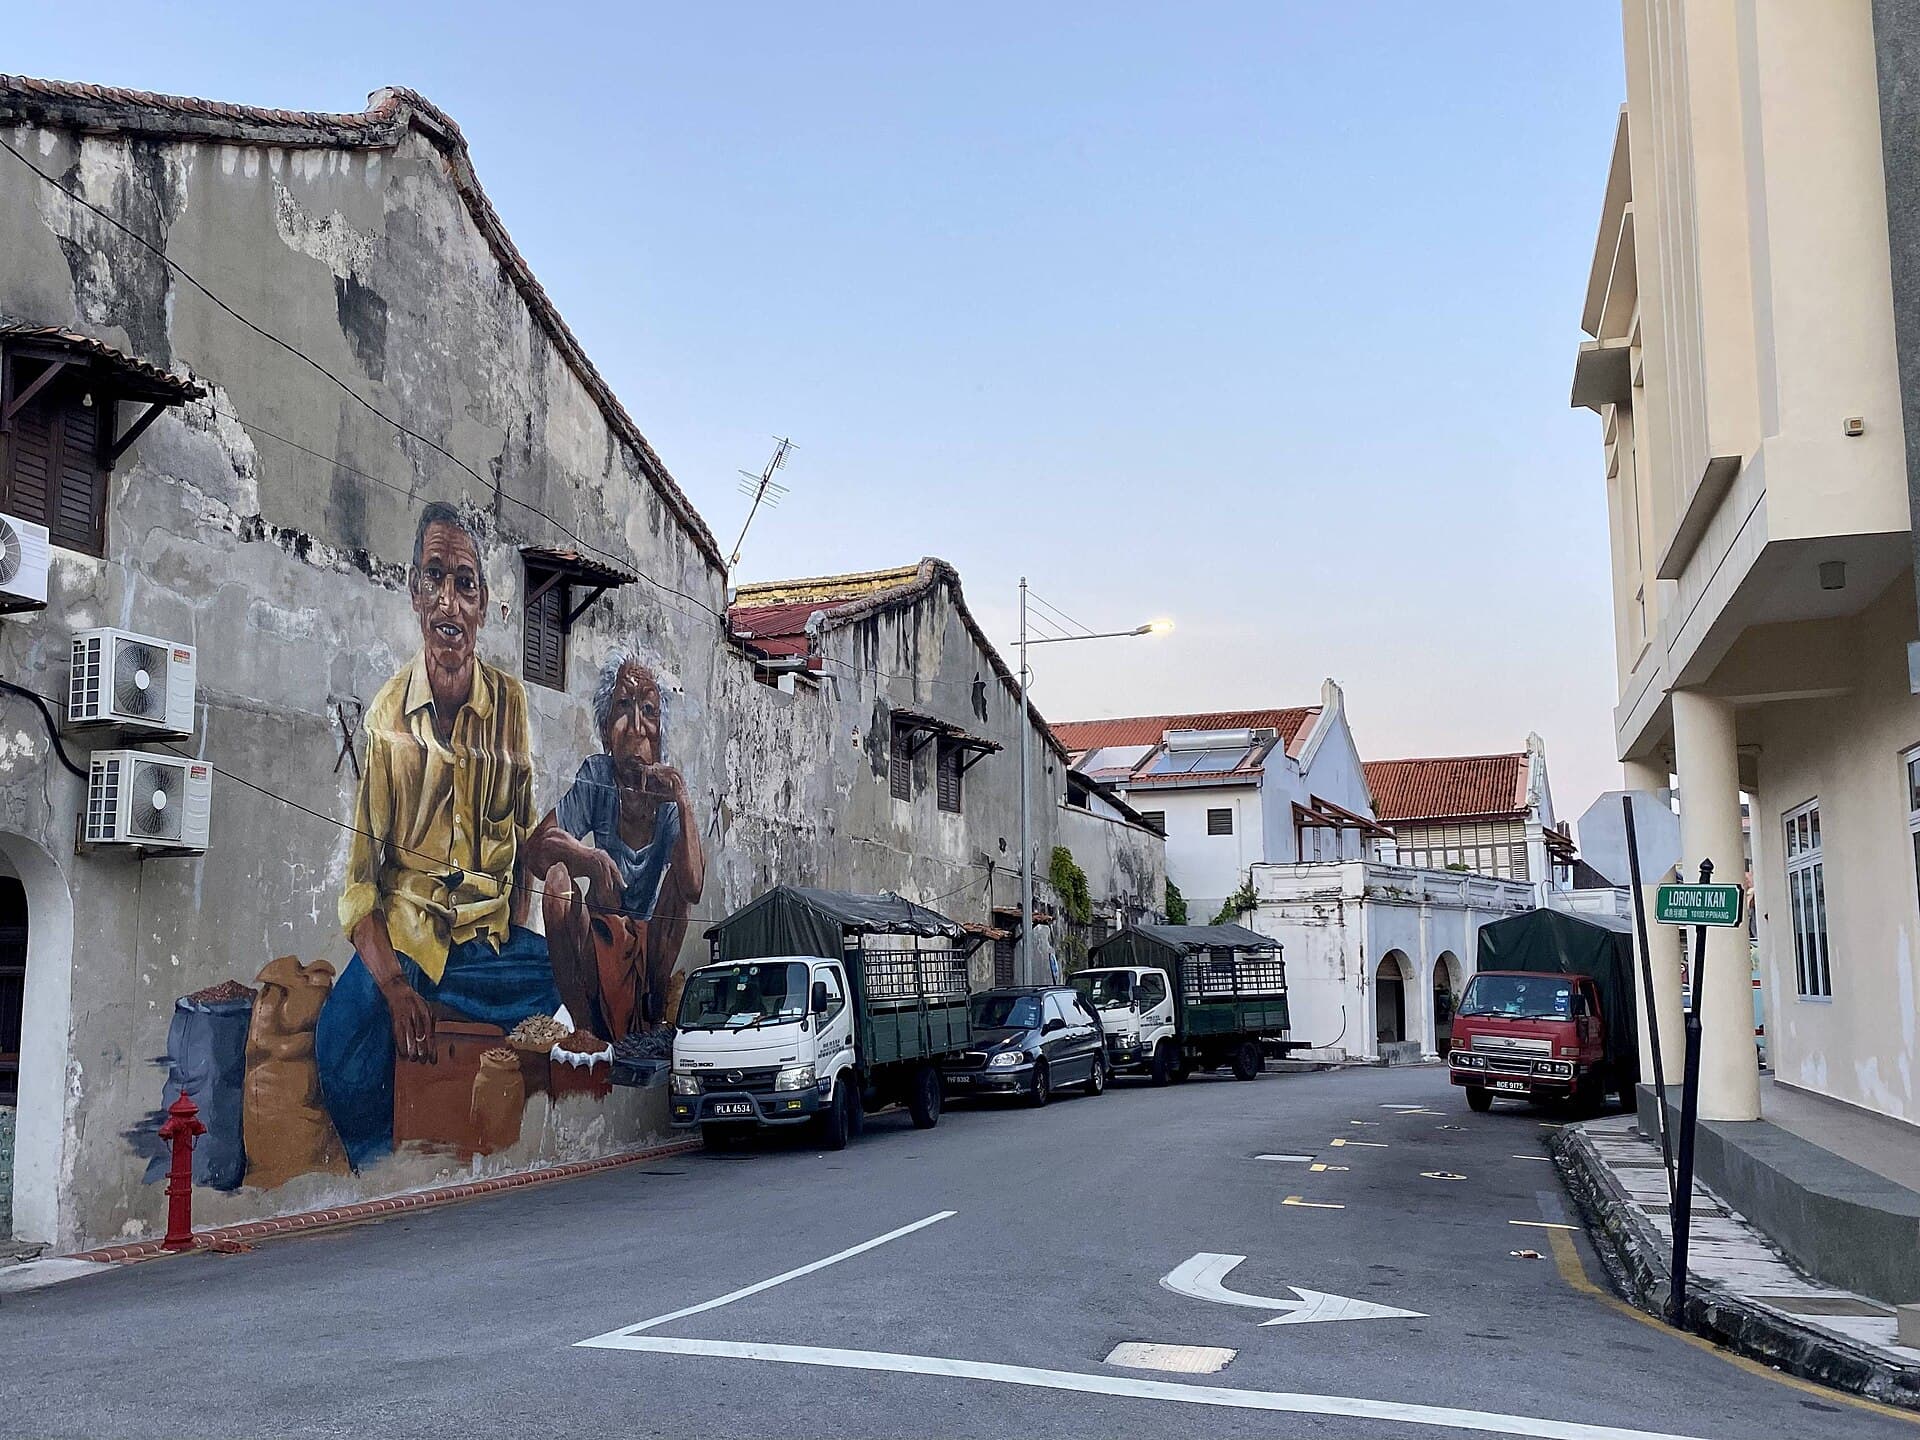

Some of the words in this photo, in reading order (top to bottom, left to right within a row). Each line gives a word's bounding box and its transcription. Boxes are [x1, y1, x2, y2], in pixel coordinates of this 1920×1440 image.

[1669, 891, 1702, 907] LORONG
[1704, 891, 1726, 908] IKAN
[716, 1105, 731, 1113] PLA
[732, 1104, 750, 1113] 4534
